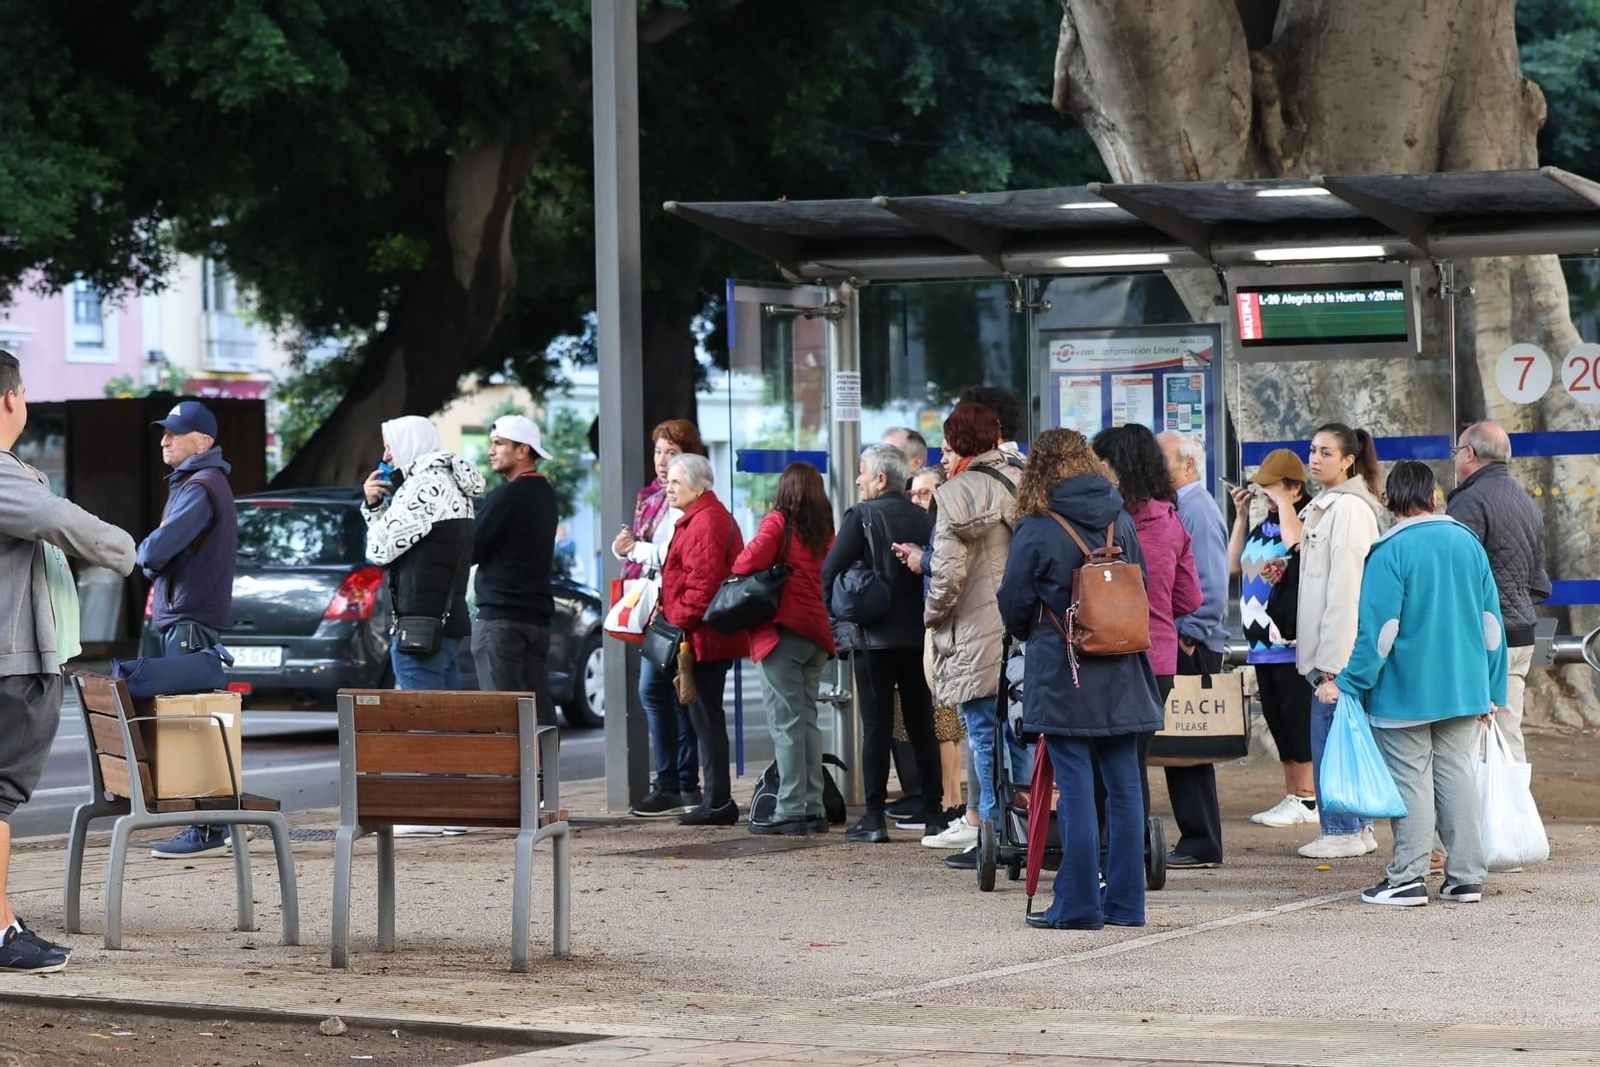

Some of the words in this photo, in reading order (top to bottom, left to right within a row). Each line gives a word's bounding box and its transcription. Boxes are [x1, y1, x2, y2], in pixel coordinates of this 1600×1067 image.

[1313, 292, 1325, 304] de
[1325, 292, 1335, 303] la
[1335, 292, 1366, 303] Huerta
[1367, 290, 1385, 302] +20
[1386, 290, 1404, 301] min
[1513, 356, 1535, 391] 7
[1165, 699, 1225, 715] EACH
[1175, 722, 1208, 731] PLEASE
